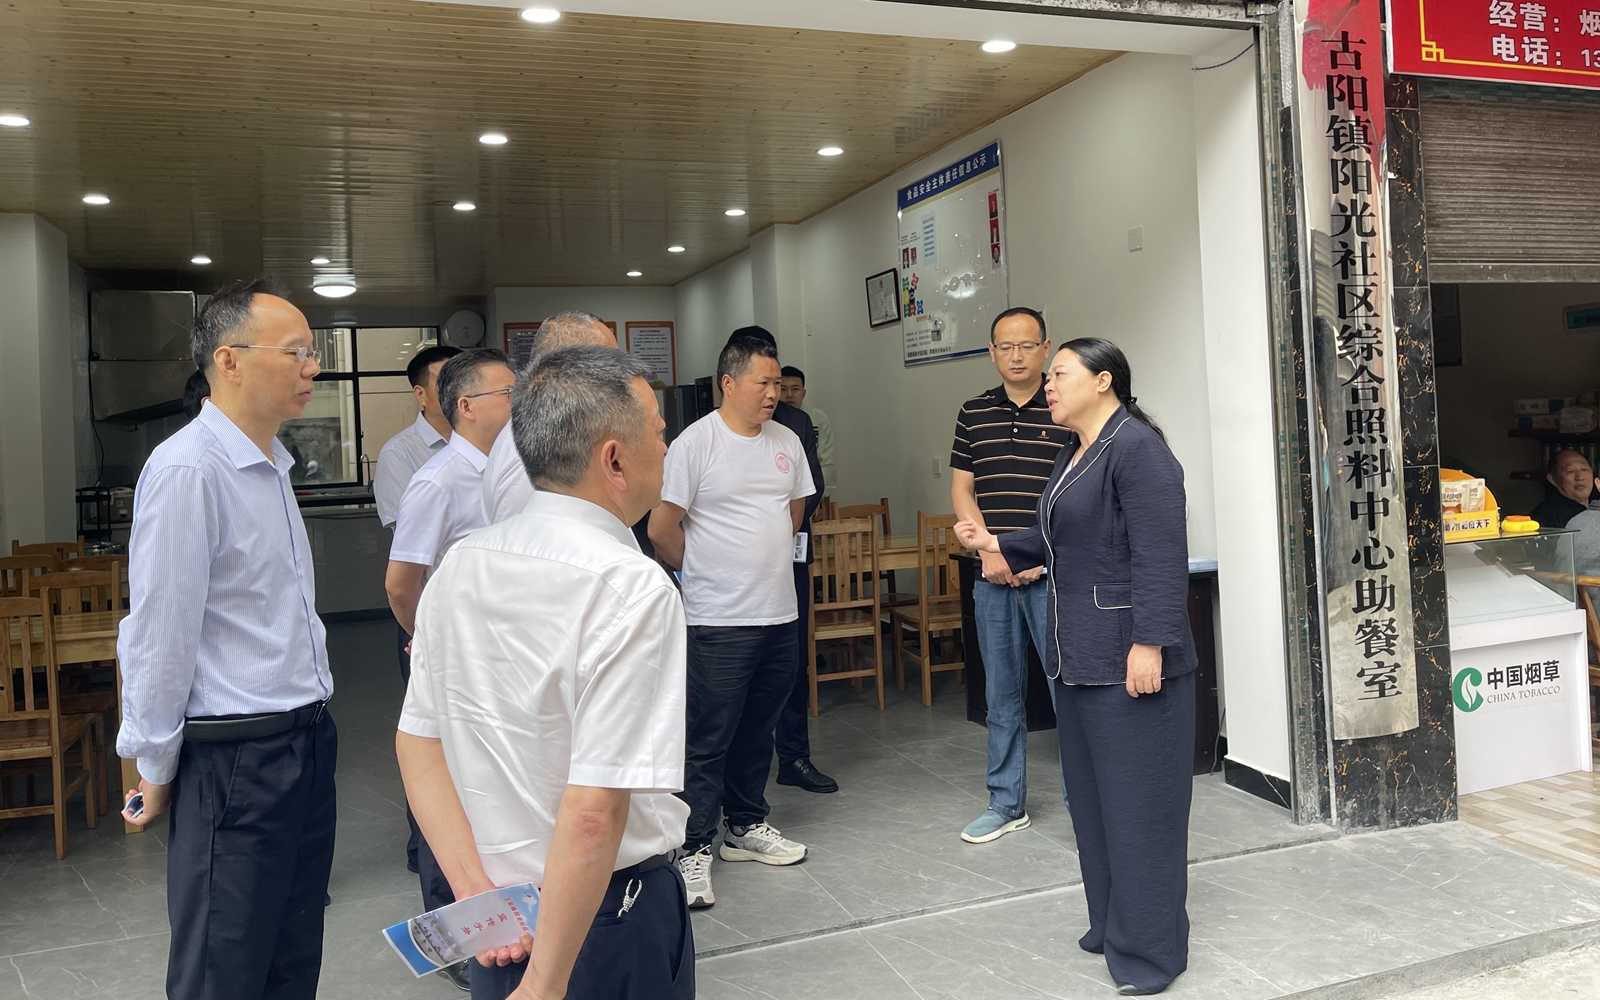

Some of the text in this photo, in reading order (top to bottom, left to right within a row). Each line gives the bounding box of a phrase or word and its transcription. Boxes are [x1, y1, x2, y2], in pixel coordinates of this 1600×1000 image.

[1320, 31, 1403, 700] 古阳镇阳光社区综合照料中心助餐室
[1487, 660, 1560, 690] 中国烟草
[1487, 685, 1561, 704] CHINA TOBACCO
